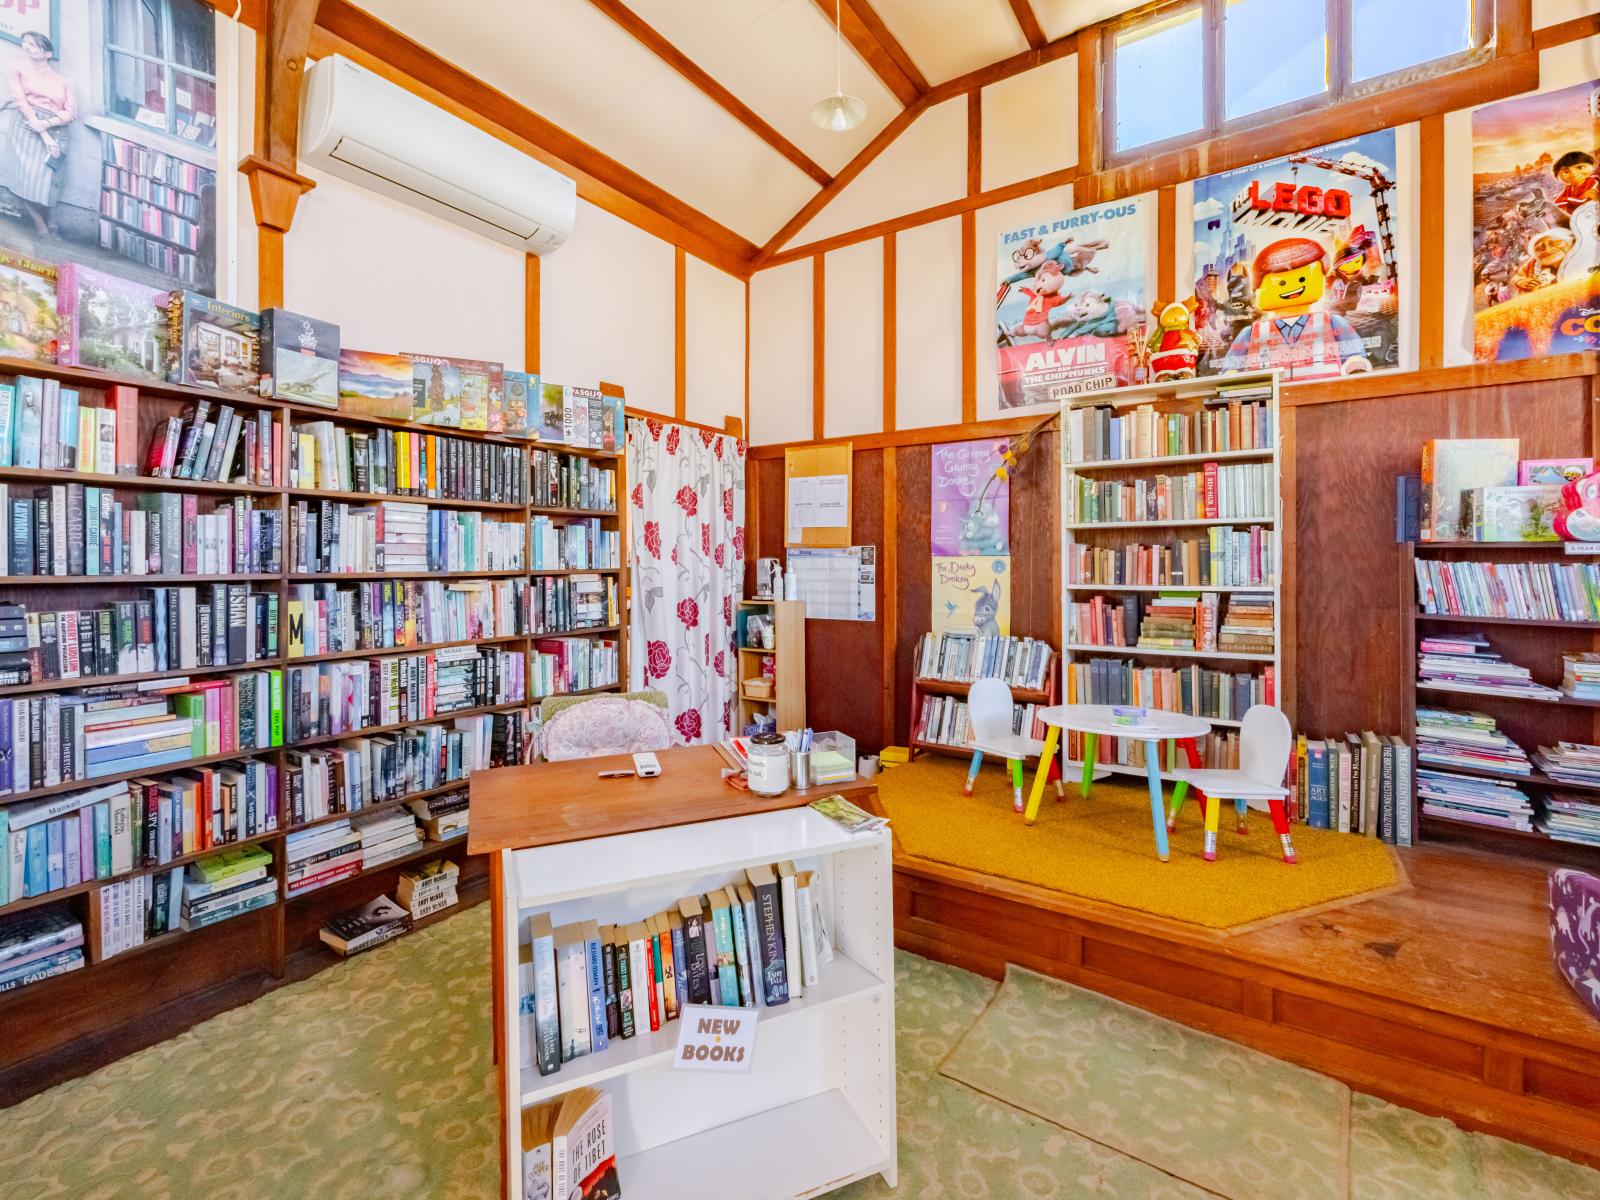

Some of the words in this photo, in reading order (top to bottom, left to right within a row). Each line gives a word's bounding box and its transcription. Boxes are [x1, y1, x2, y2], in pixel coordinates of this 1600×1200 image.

[1250, 180, 1352, 220] LEGO
[1003, 227, 1034, 244] FAST
[1037, 224, 1048, 236] &
[1052, 203, 1137, 233] FURRY-OUS
[208, 300, 250, 322] Interiors
[1024, 343, 1105, 373] ALVIN
[1024, 373, 1044, 384] THE
[1043, 367, 1105, 381] CHIPMUNKS
[1052, 384, 1083, 398] ROAD
[1085, 377, 1113, 391] CHIP
[936, 446, 952, 461] The
[944, 460, 980, 477] Granny
[937, 475, 977, 497] Donkey
[1206, 476, 1214, 508] BEN-HUR
[101, 493, 112, 519] Leather
[15, 502, 29, 539] LAYMON
[273, 517, 282, 542] LEON
[260, 525, 268, 545] LEON
[949, 561, 976, 578] Dinky
[940, 574, 970, 591] Donkey
[230, 595, 247, 628] SHAN
[66, 613, 77, 642] ROBERT
[289, 613, 304, 645] M
[68, 643, 79, 673] LUDLUM
[1399, 748, 1409, 763] THE
[1310, 786, 1326, 794] ART
[1383, 778, 1393, 805] WESTERN
[1399, 763, 1409, 806] EIGHTEENTH
[49, 798, 81, 817] Mankell
[429, 800, 445, 809] LONG
[148, 812, 158, 828] SPY
[1383, 804, 1393, 838] CIVILIZATION
[1399, 806, 1409, 839] CENTURY
[417, 898, 429, 907] ANDY
[429, 892, 444, 903] McNAB
[761, 894, 776, 941] STEPHEN
[590, 942, 598, 966] RICHARD
[695, 951, 705, 978] LOVE
[691, 962, 701, 990] BITES
[697, 1018, 741, 1035] NEW
[682, 1044, 745, 1063] BOOKS
[572, 1140, 583, 1166] THE
[587, 1119, 606, 1148] ROSE
[573, 1163, 581, 1184] OF
[585, 1139, 606, 1171] TIBET
